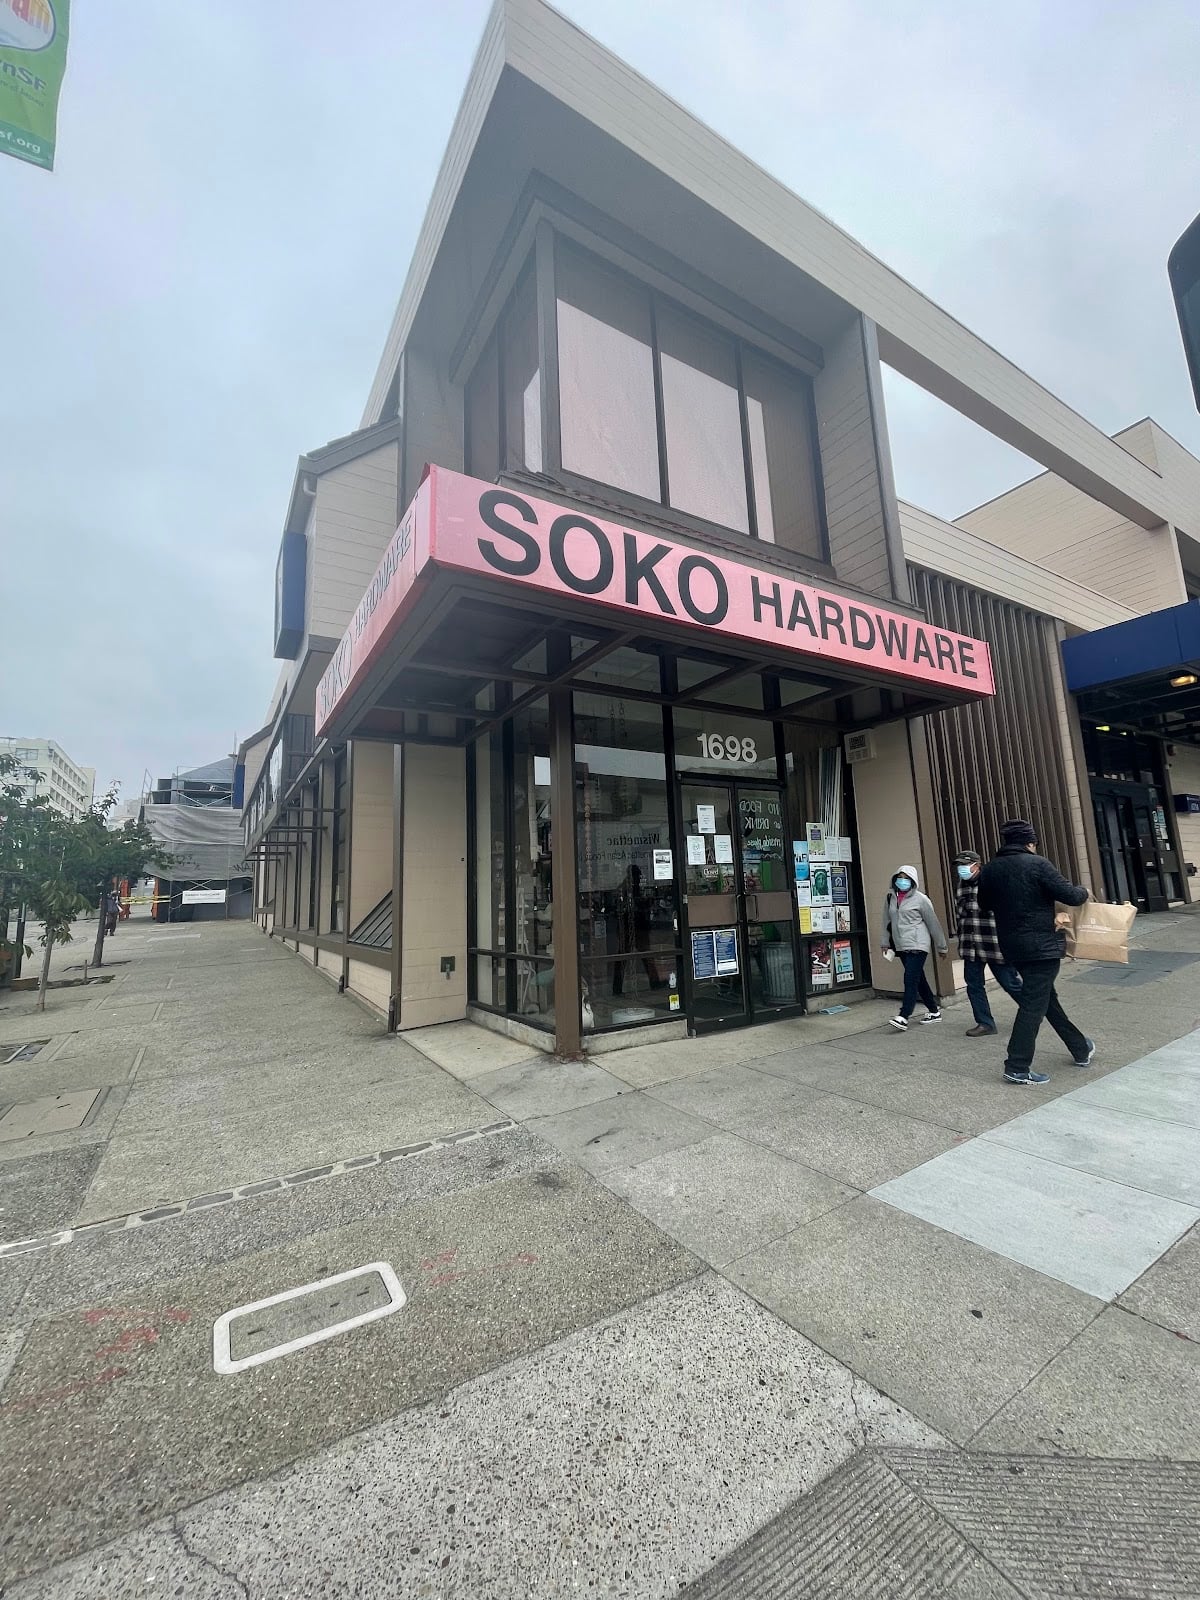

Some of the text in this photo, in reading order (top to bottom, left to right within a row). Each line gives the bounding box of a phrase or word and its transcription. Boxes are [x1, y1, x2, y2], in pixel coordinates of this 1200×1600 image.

[319, 509, 413, 723] SOKO HARDWARE
[477, 488, 979, 680] SOKO HARDWARE
[696, 733, 758, 764] 1698
